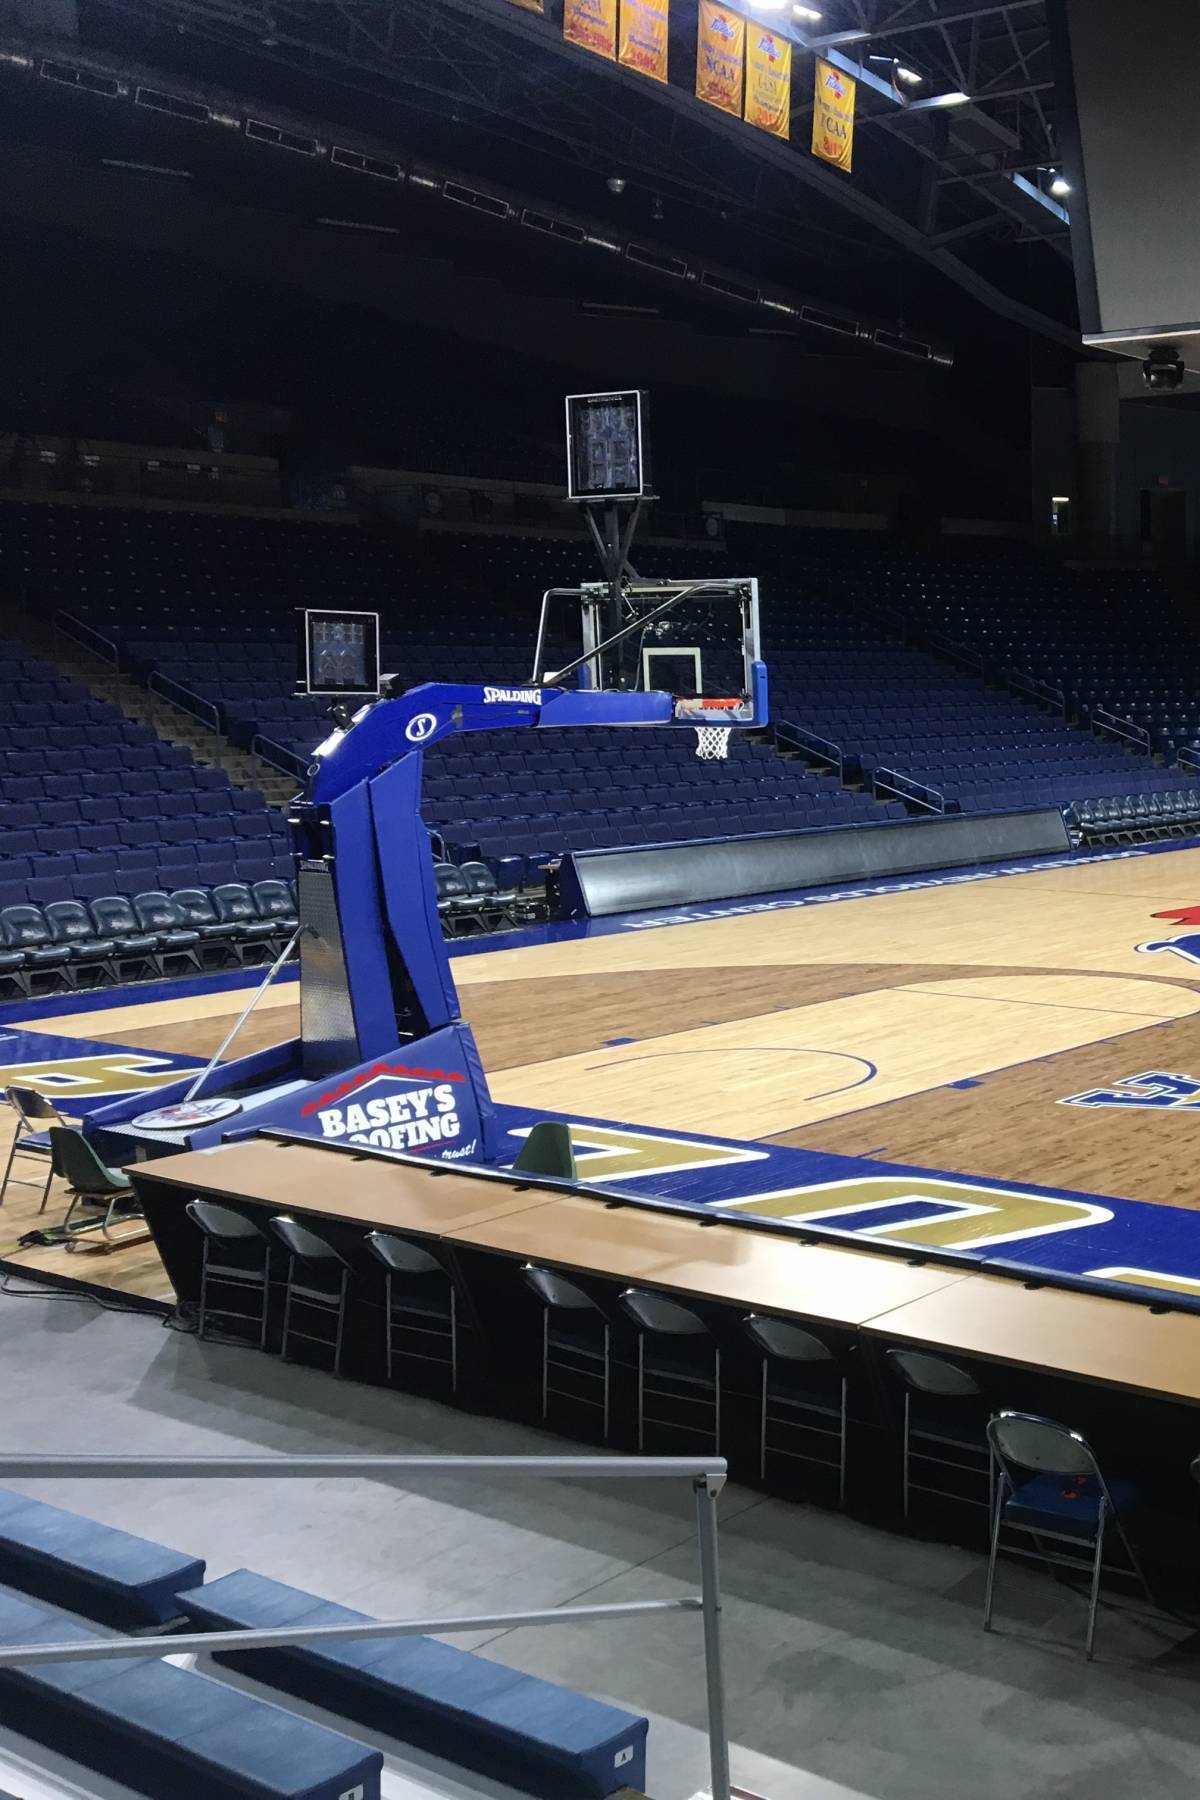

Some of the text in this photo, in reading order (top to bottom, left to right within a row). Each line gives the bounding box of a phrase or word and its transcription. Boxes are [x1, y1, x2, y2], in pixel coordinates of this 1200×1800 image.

[483, 686, 543, 706] SPALDING
[620, 900, 804, 928] CENTER
[318, 1084, 456, 1137] BASEY'S
[348, 1112, 461, 1150] OFING
